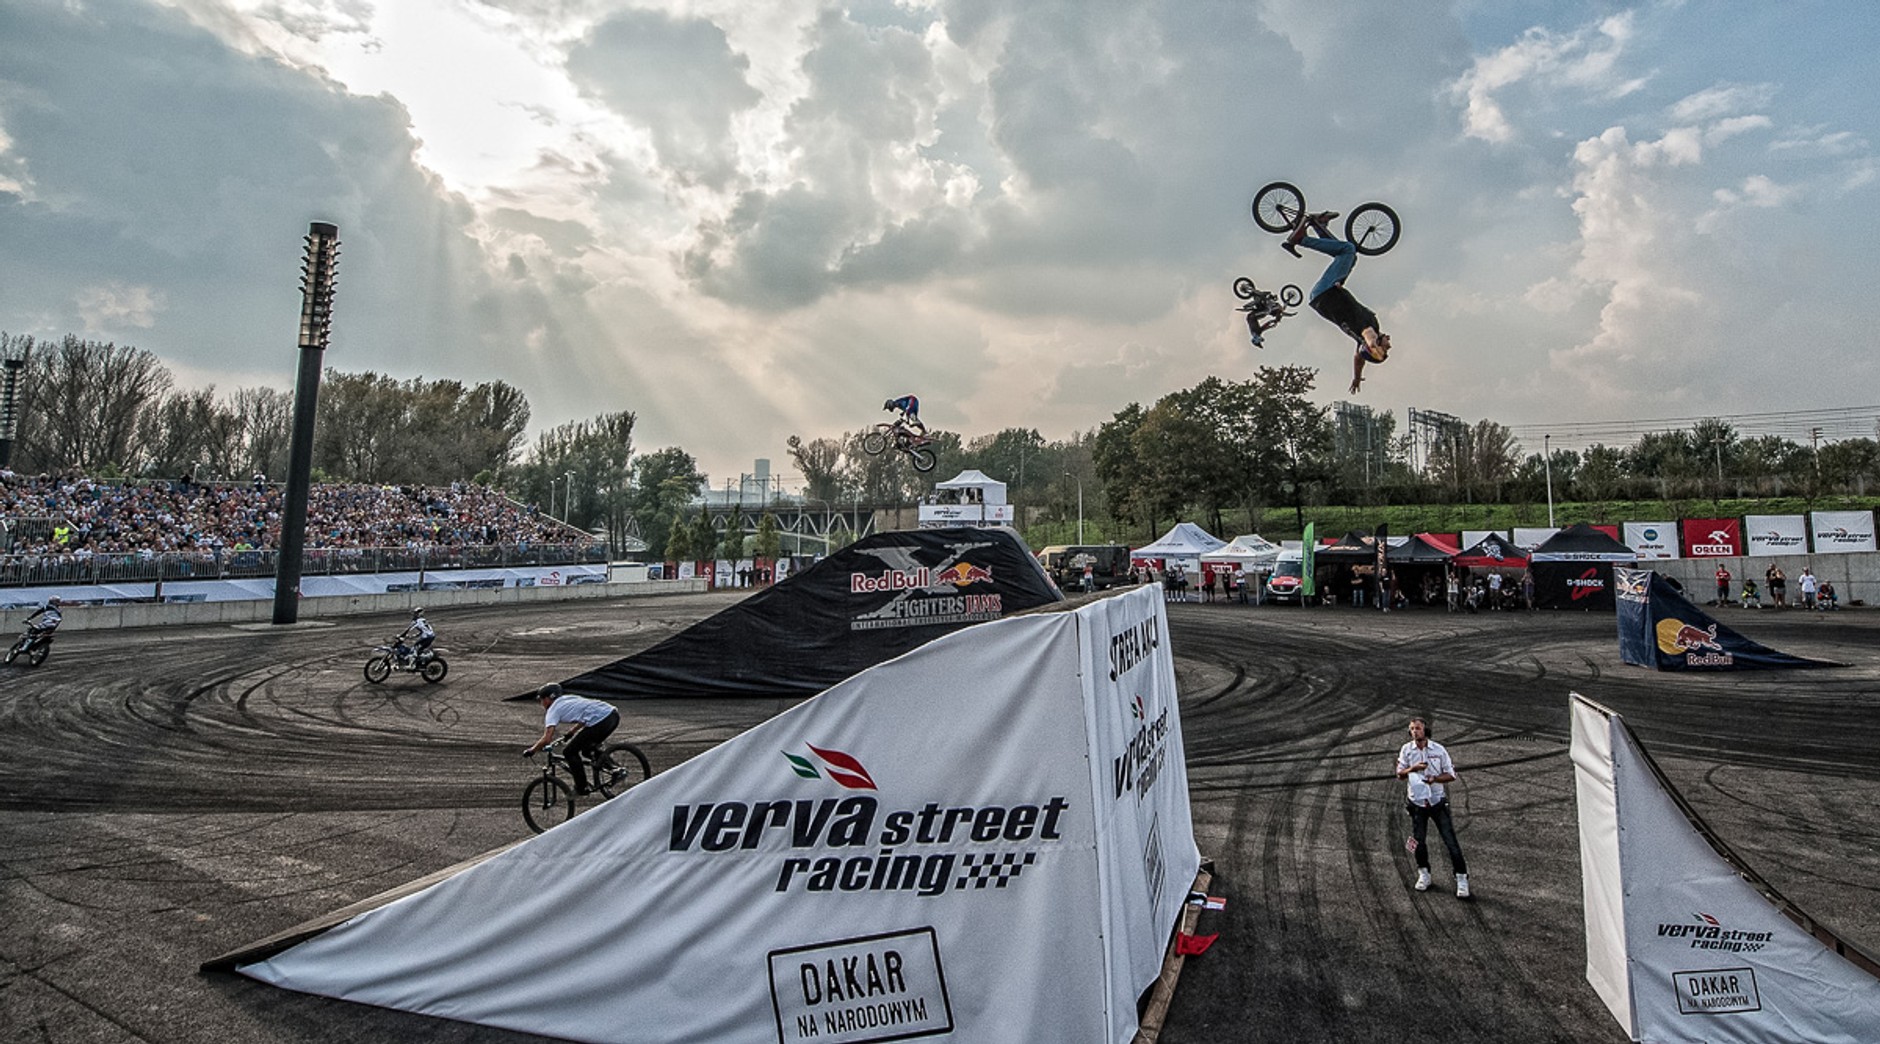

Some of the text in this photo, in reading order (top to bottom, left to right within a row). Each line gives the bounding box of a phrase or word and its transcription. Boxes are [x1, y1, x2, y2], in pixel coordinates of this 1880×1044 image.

[1694, 546, 1731, 554] ORLEN
[851, 566, 930, 593] Red Bull
[1566, 578, 1604, 587] G-SHOCK
[896, 594, 1002, 617] FIGHTERS JAMS
[669, 797, 1069, 851] verva street
[775, 849, 955, 896] racing
[1657, 924, 1773, 942] verva street
[1691, 940, 1742, 953] racing
[800, 950, 906, 1006] DAKAR
[1689, 975, 1739, 996] DAKAR
[797, 997, 928, 1038] NA NARODOWYM
